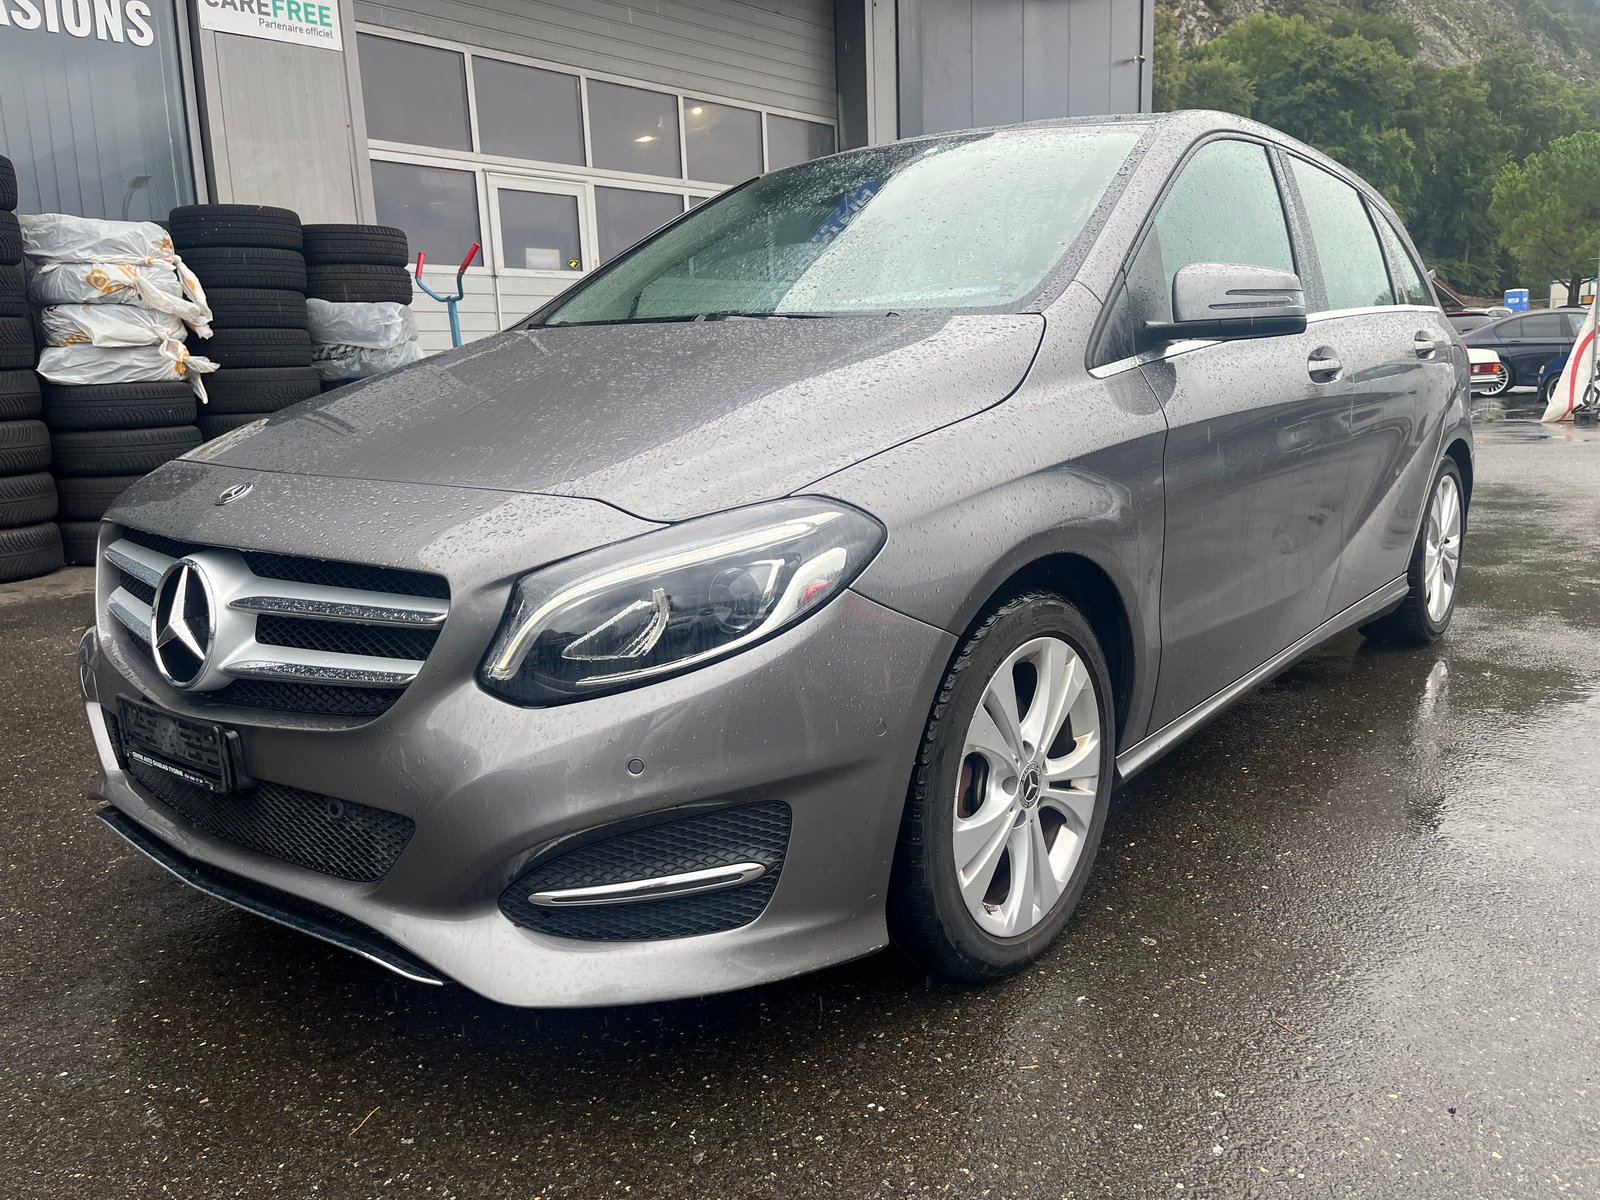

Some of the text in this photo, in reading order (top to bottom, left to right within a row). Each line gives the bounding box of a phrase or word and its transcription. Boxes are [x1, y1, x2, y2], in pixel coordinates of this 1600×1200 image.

[0, 0, 154, 47] SIONS
[258, 18, 334, 39] Partenaire officiel
